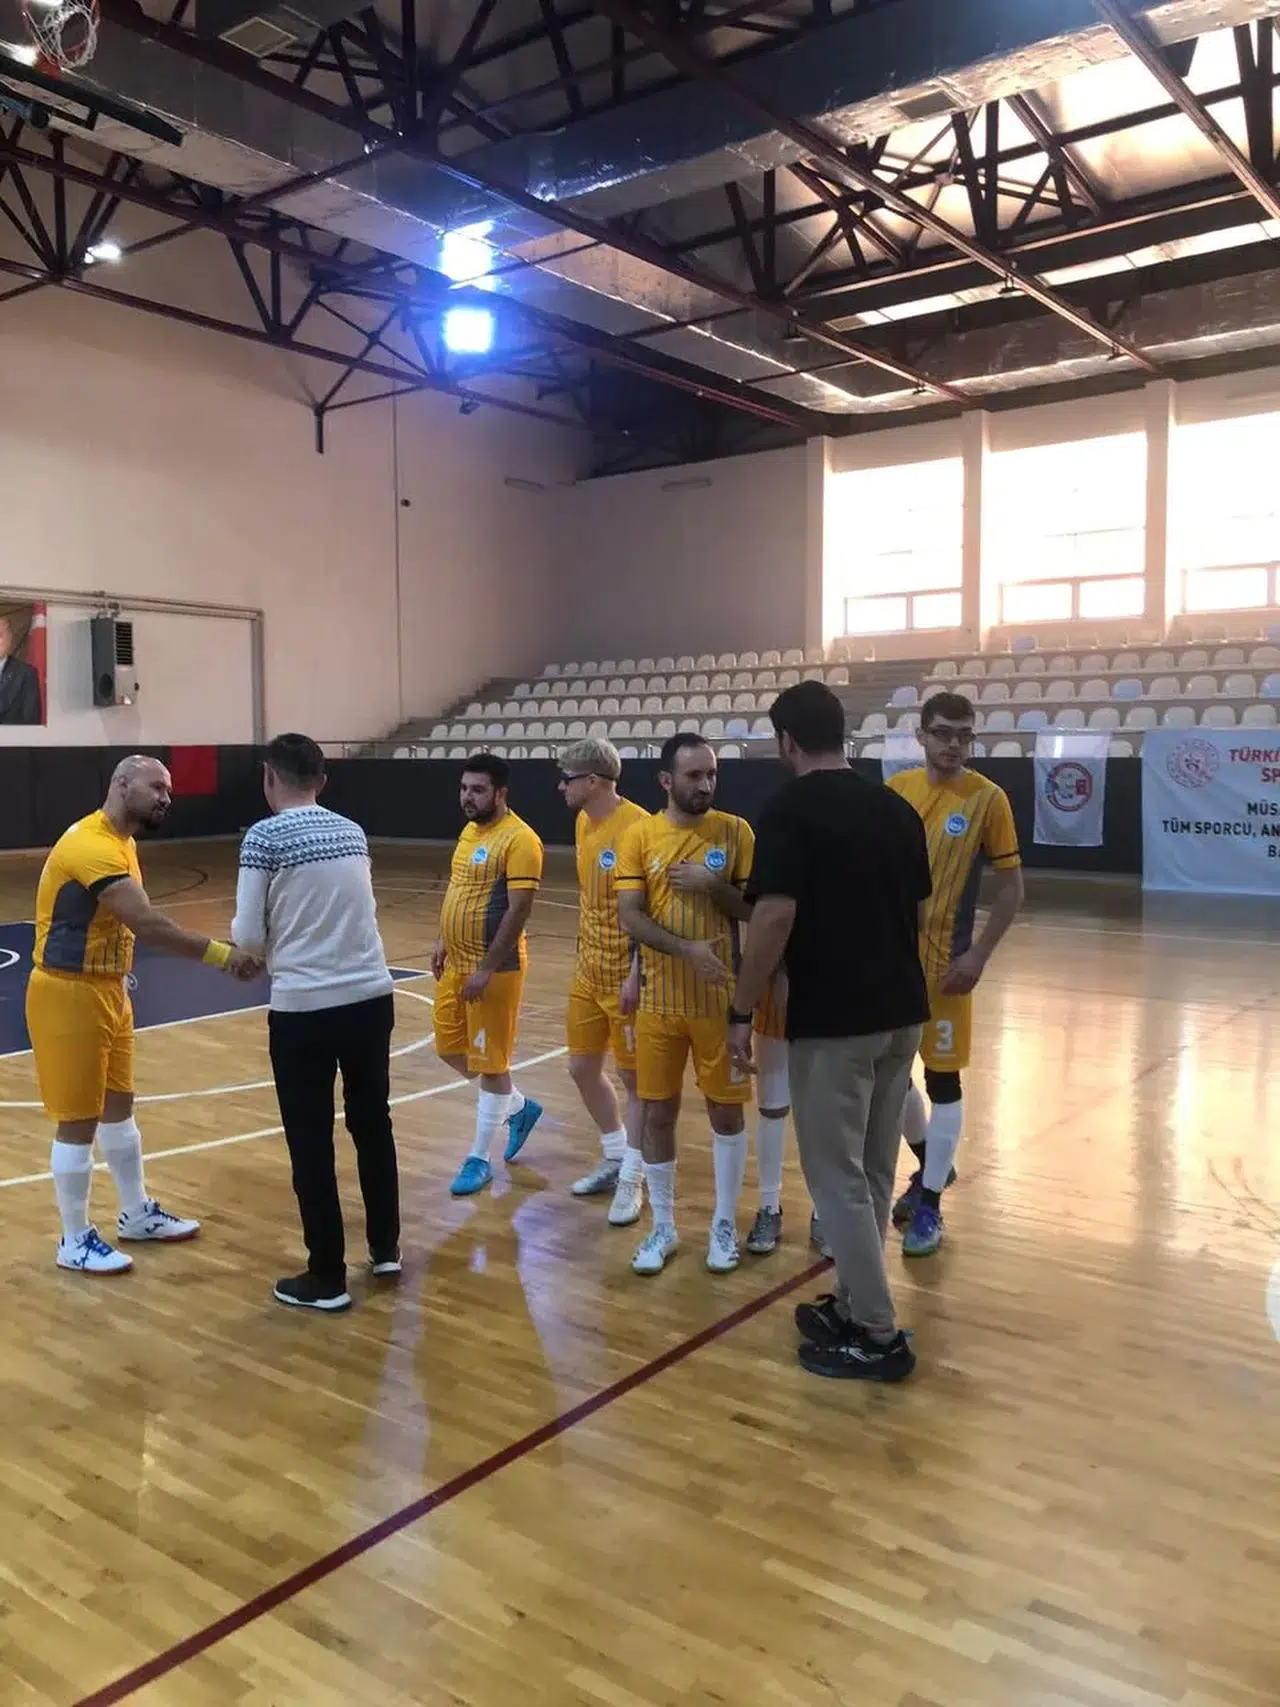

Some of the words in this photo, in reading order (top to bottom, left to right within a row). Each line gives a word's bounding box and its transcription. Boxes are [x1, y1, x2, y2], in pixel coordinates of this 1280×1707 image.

[1247, 799, 1280, 816] MÜS
[1162, 818, 1191, 834] TÜM
[1194, 821, 1257, 838] SPORCU,
[1267, 844, 1280, 858] B
[473, 1027, 486, 1055] 4
[935, 1019, 954, 1051] 3
